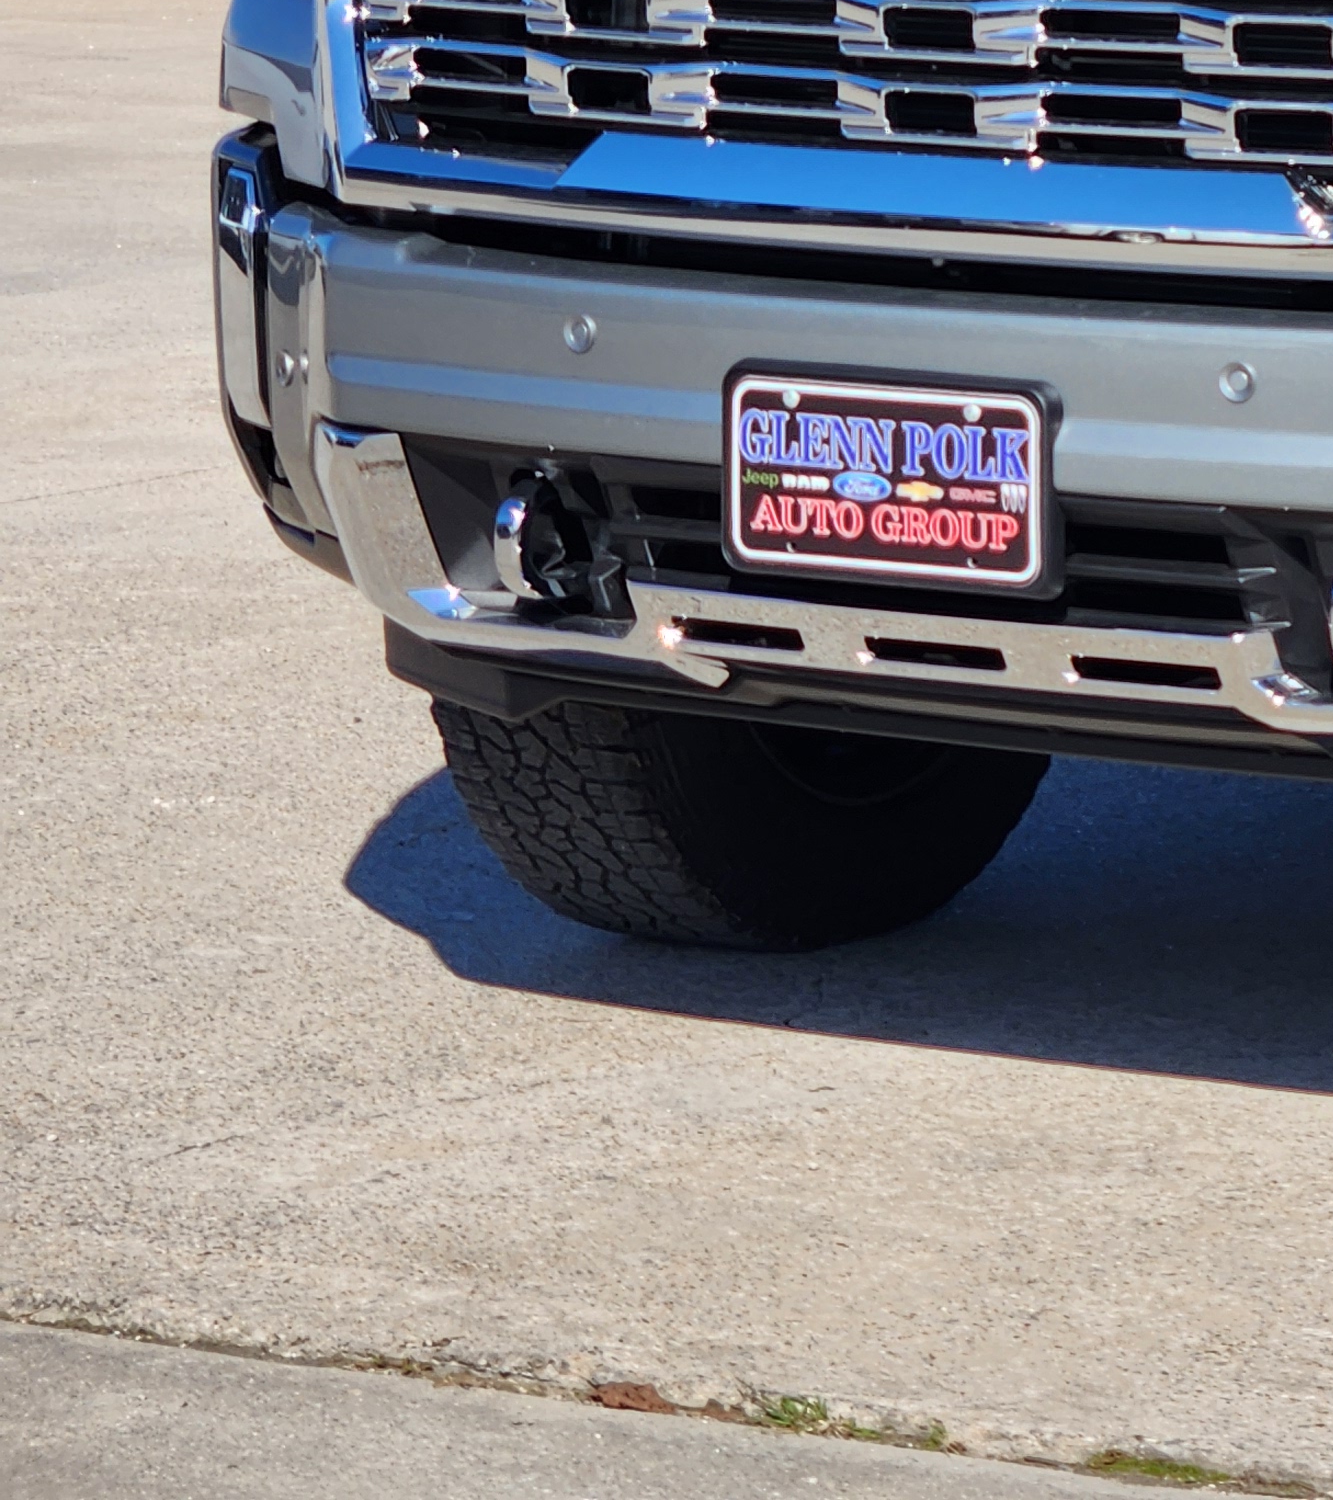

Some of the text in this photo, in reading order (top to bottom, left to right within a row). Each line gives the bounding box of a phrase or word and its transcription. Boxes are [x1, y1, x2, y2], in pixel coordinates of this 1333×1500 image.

[738, 407, 1031, 483] GLENN POLK
[742, 468, 779, 489] Jeep
[781, 472, 830, 492] RAM
[948, 486, 998, 504] GMC
[749, 494, 1021, 553] AUTO GROUP
